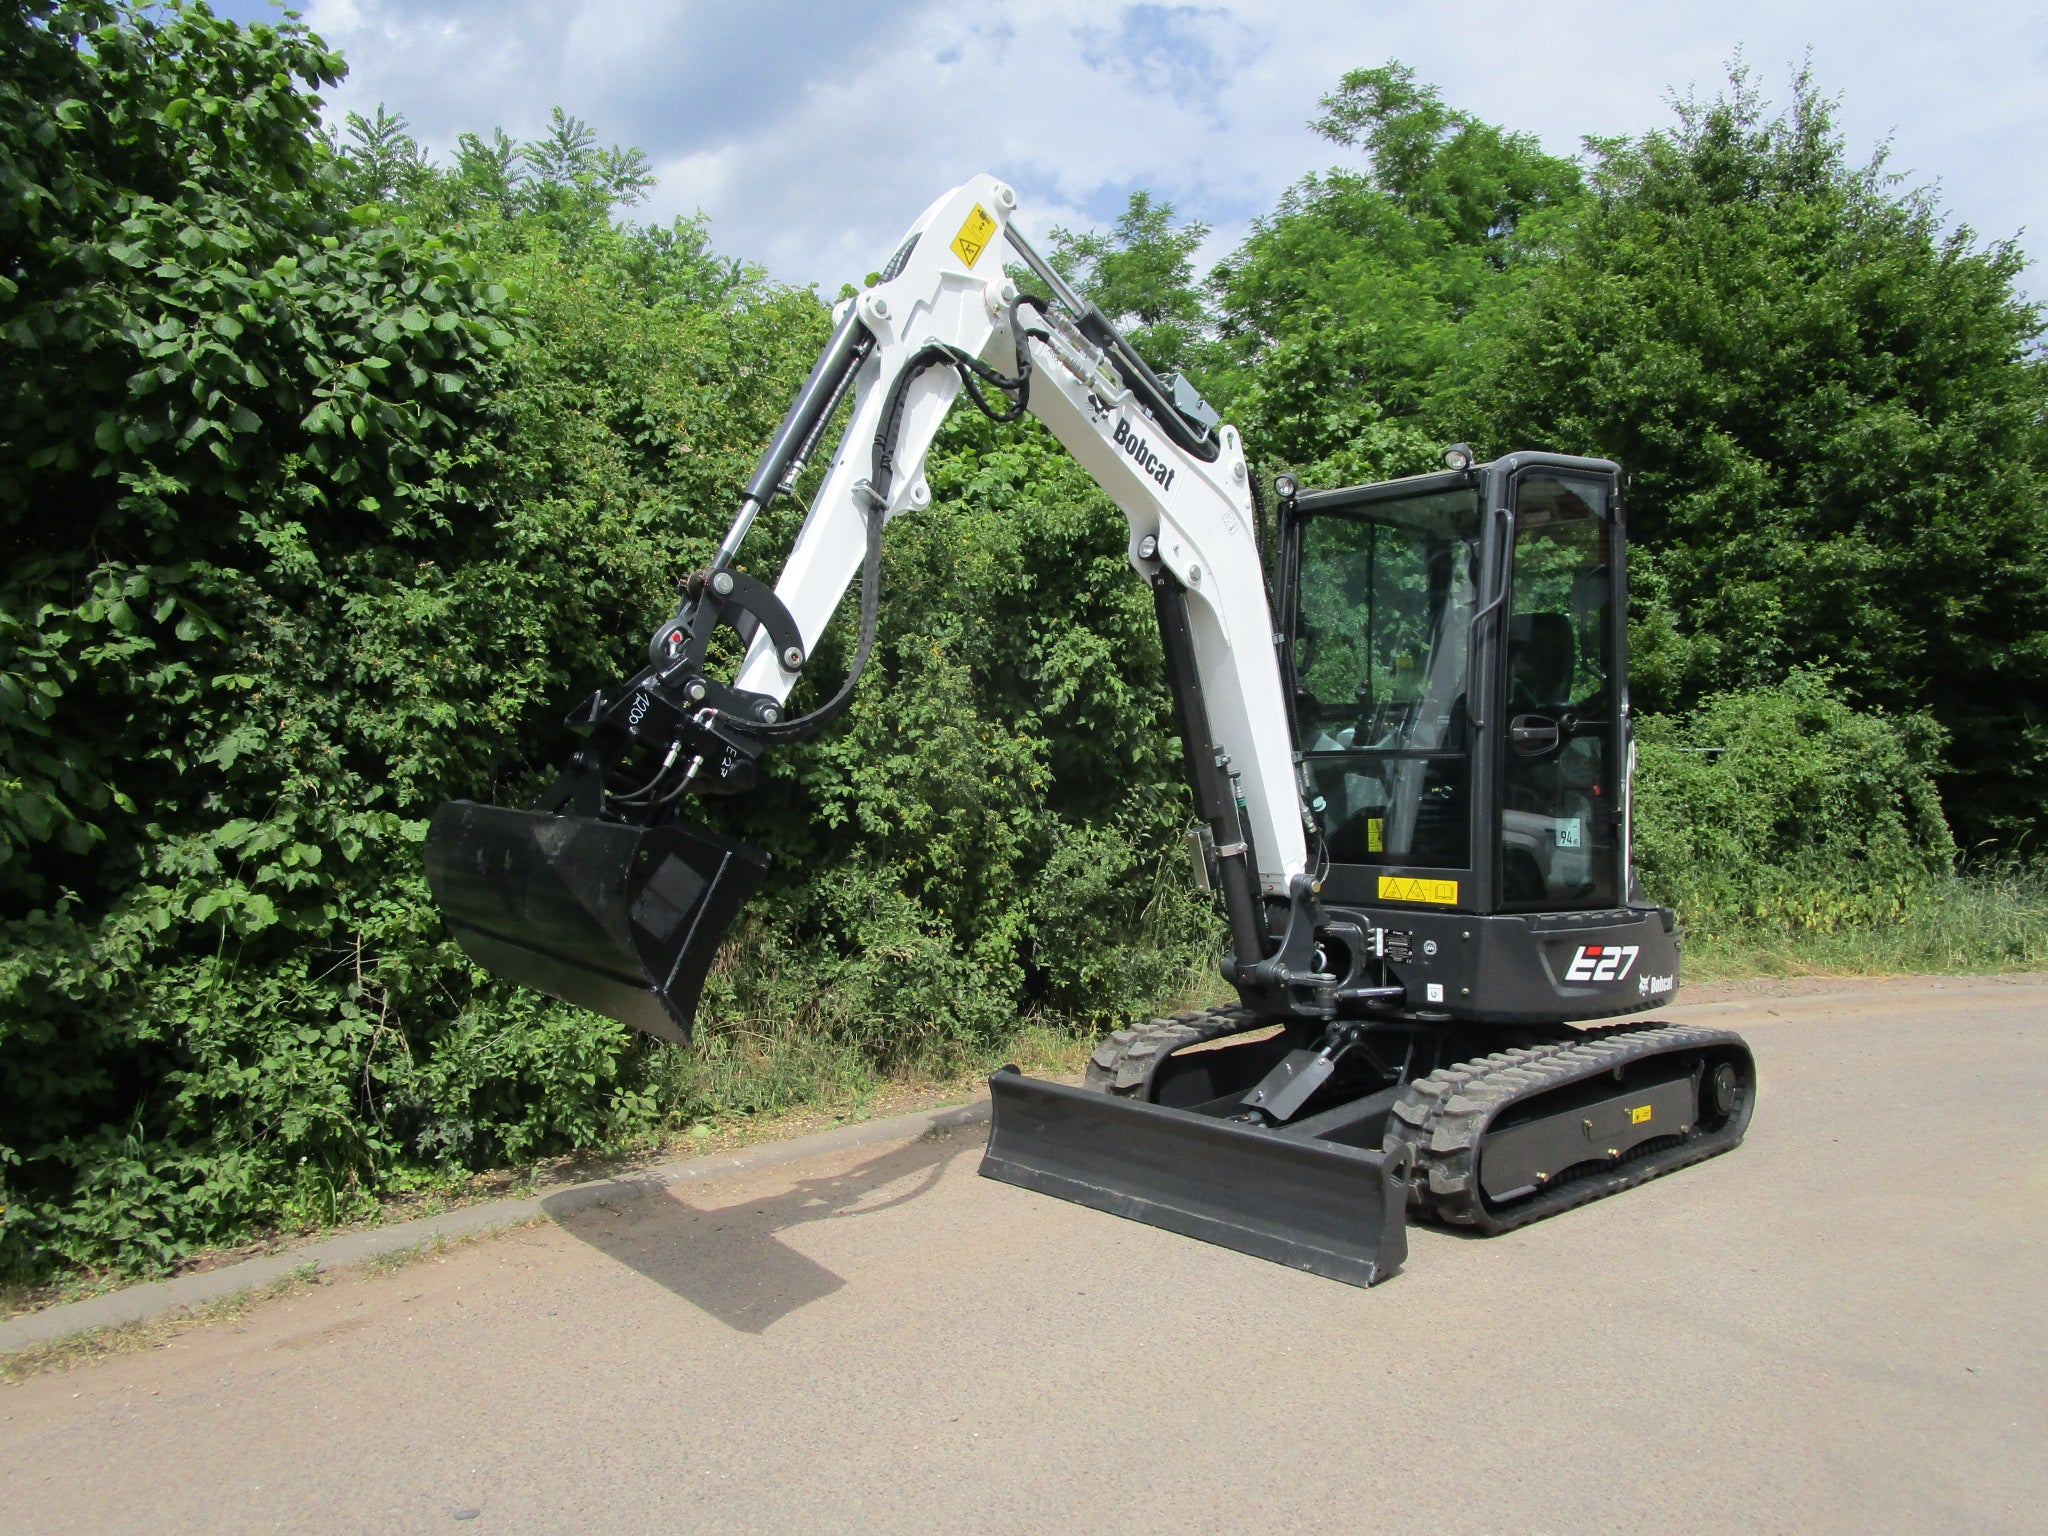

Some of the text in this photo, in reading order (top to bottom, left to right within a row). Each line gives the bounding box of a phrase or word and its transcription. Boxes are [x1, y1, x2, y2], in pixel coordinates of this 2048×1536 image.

[1113, 417, 1175, 492] Bobcat
[629, 692, 650, 724] 1200
[1560, 830, 1572, 844] 94
[1564, 945, 1640, 981] E27
[1650, 974, 1673, 993] Bobcat
